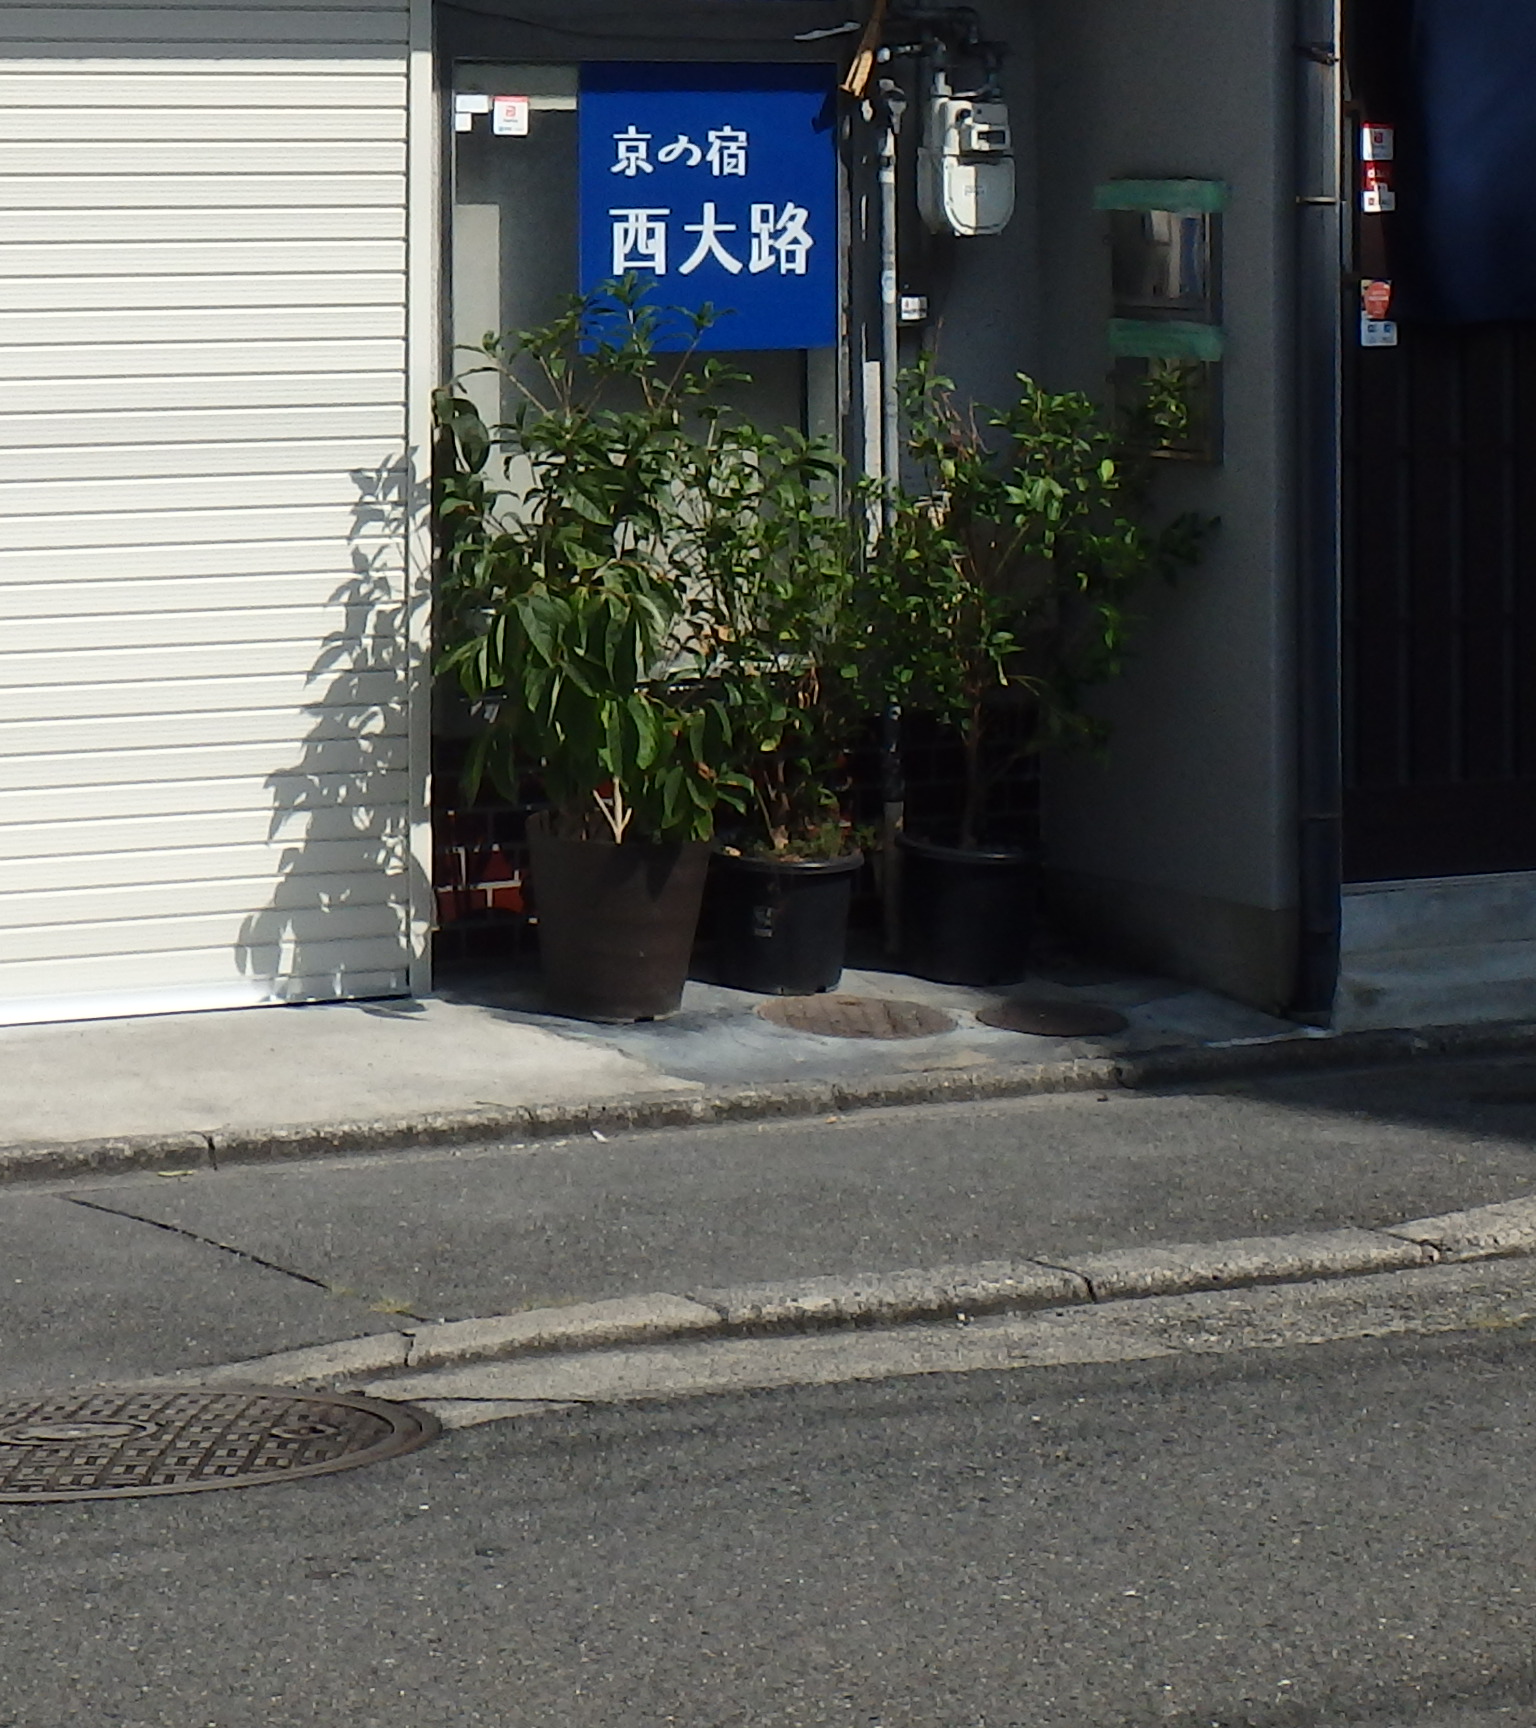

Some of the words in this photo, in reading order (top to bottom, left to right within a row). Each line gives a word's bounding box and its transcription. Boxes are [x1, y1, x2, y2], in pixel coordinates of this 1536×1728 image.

[610, 124, 749, 177] 京の宿
[608, 201, 815, 276] 西大路
